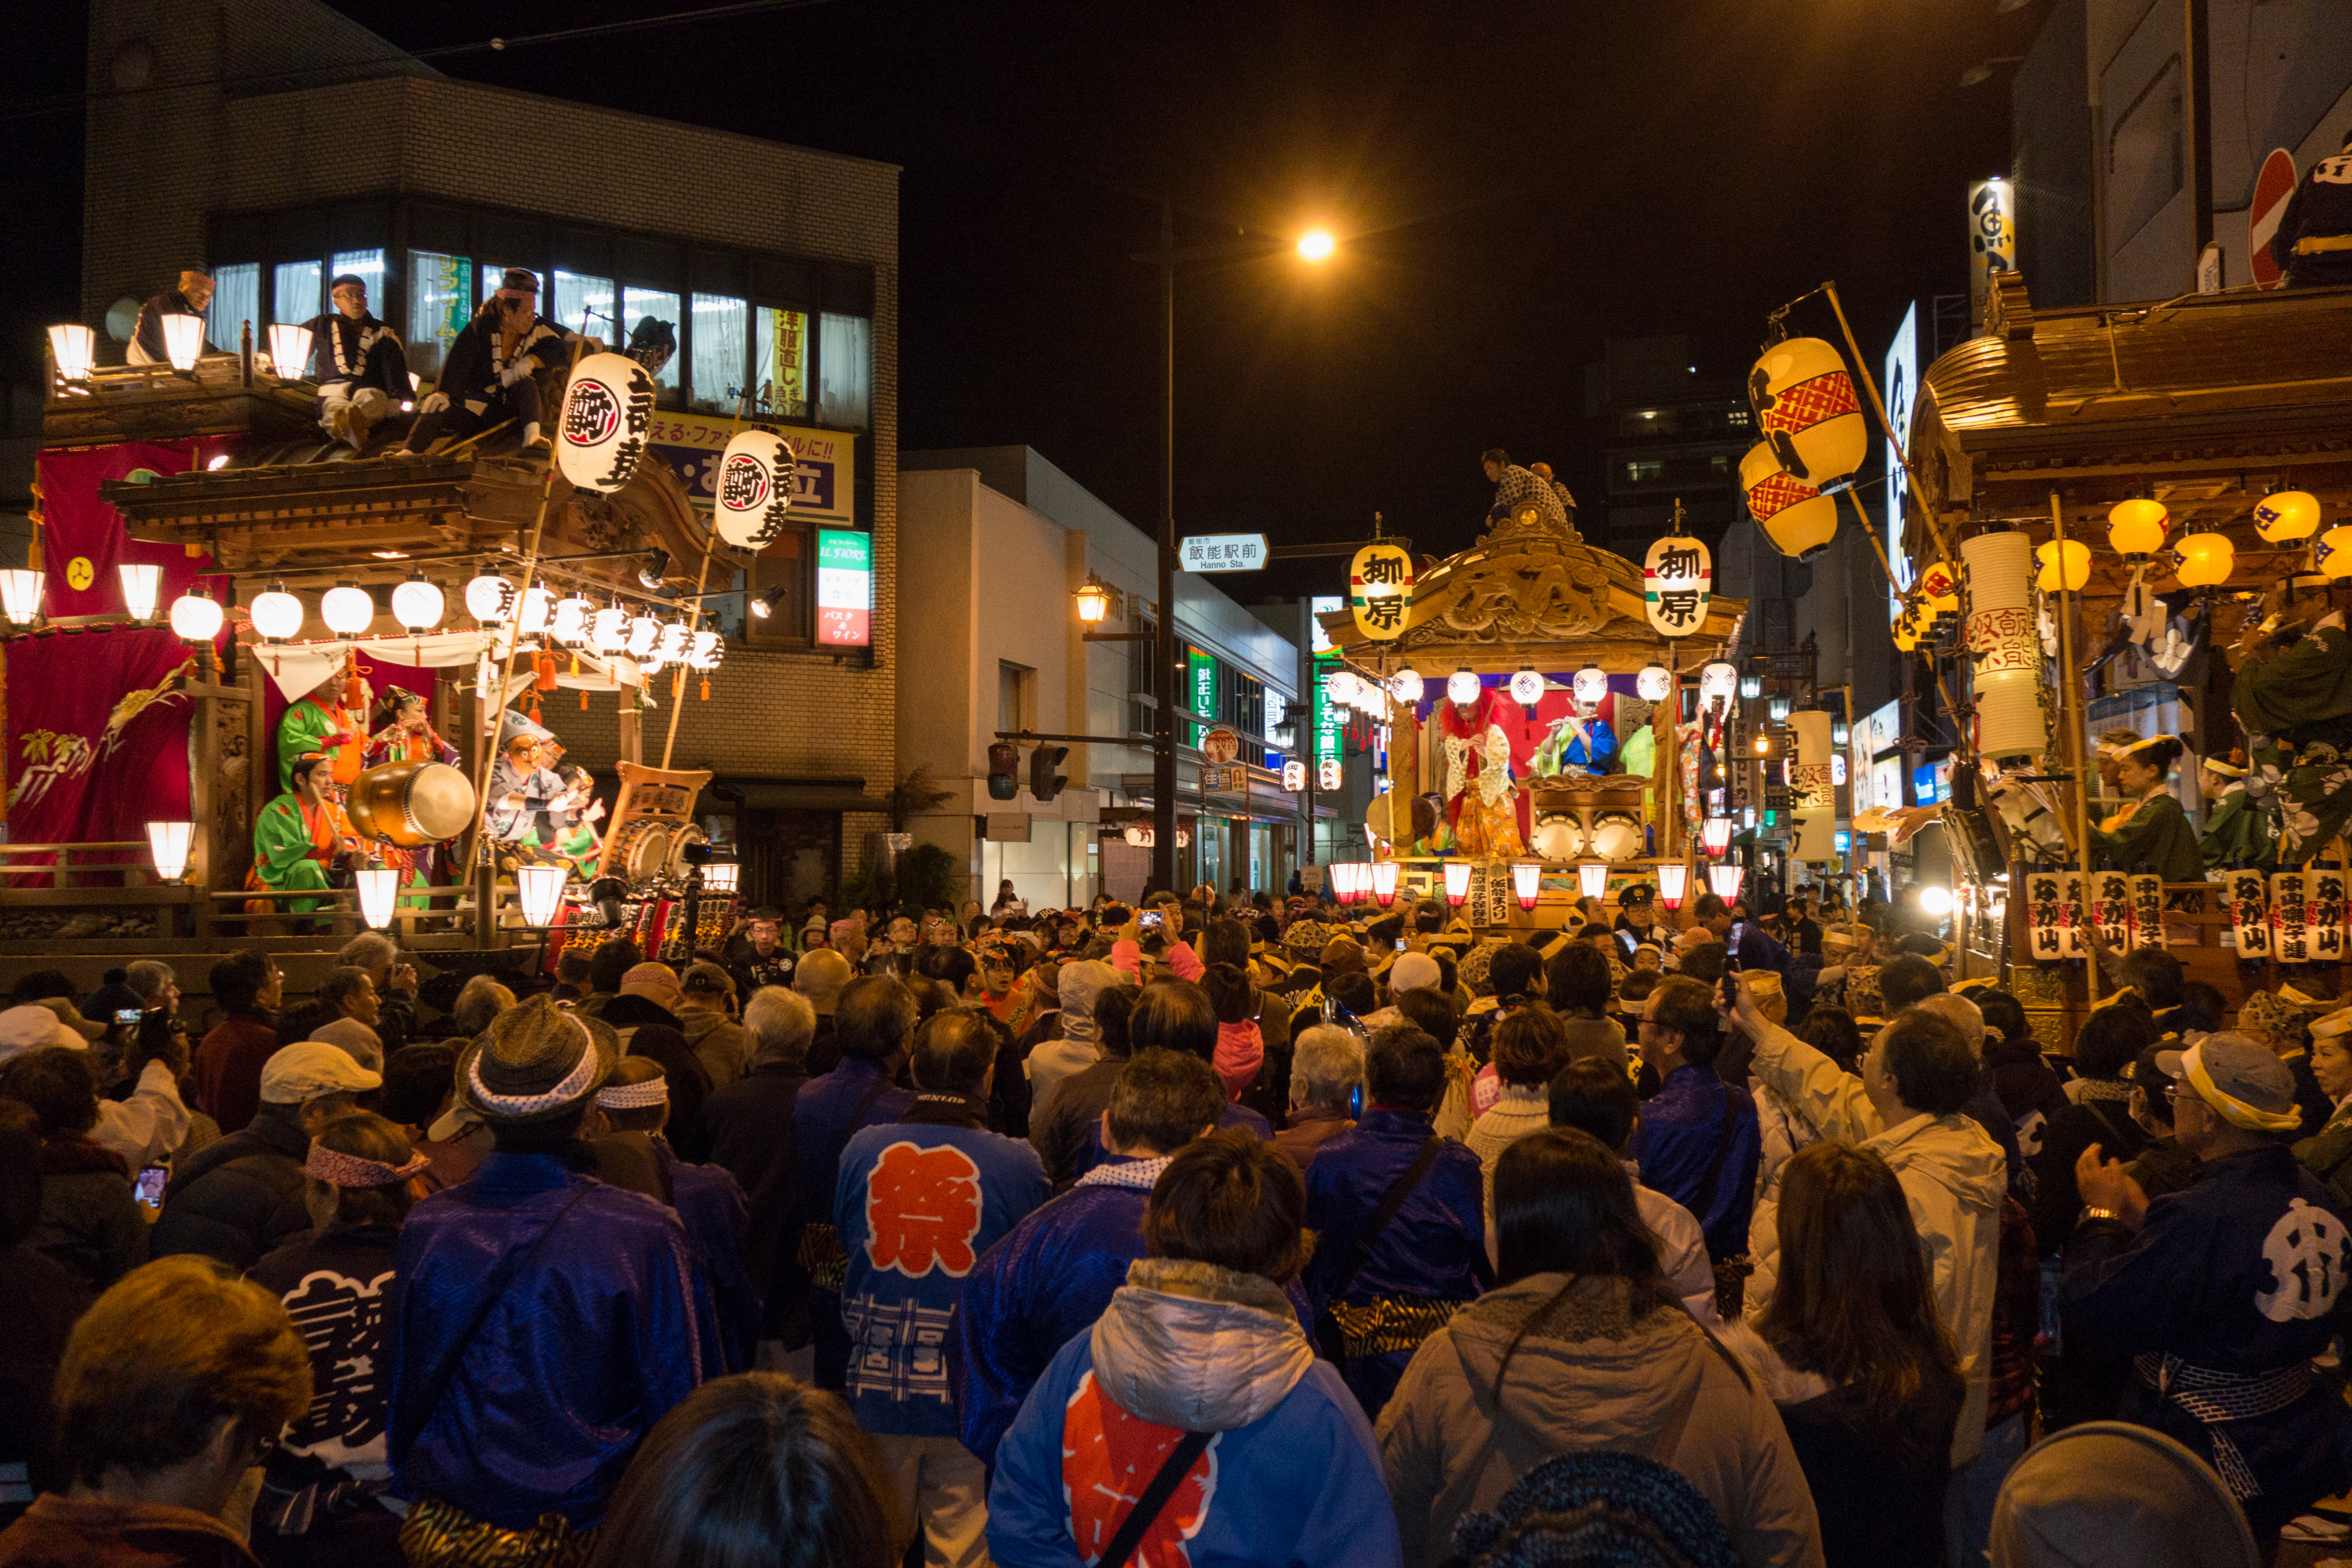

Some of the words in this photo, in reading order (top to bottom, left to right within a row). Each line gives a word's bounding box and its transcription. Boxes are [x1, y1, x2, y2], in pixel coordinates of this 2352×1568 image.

[779, 310, 799, 386] 洋服直し
[820, 546, 832, 557] IL
[833, 548, 867, 561] FIORE
[1189, 543, 1257, 561] 飯能駅前
[826, 575, 861, 584] イタリア
[1363, 554, 1403, 630] 柳原
[1657, 545, 1700, 627] 柳原
[824, 611, 853, 620] パスタ
[833, 630, 861, 640] ワイン
[1207, 739, 1235, 753] 消火栓
[1204, 773, 1230, 783] 住協
[1490, 879, 1506, 920] 飯能まつり
[2234, 877, 2267, 951] なか山
[2034, 878, 2059, 953] なか山
[2317, 876, 2343, 953] なか山
